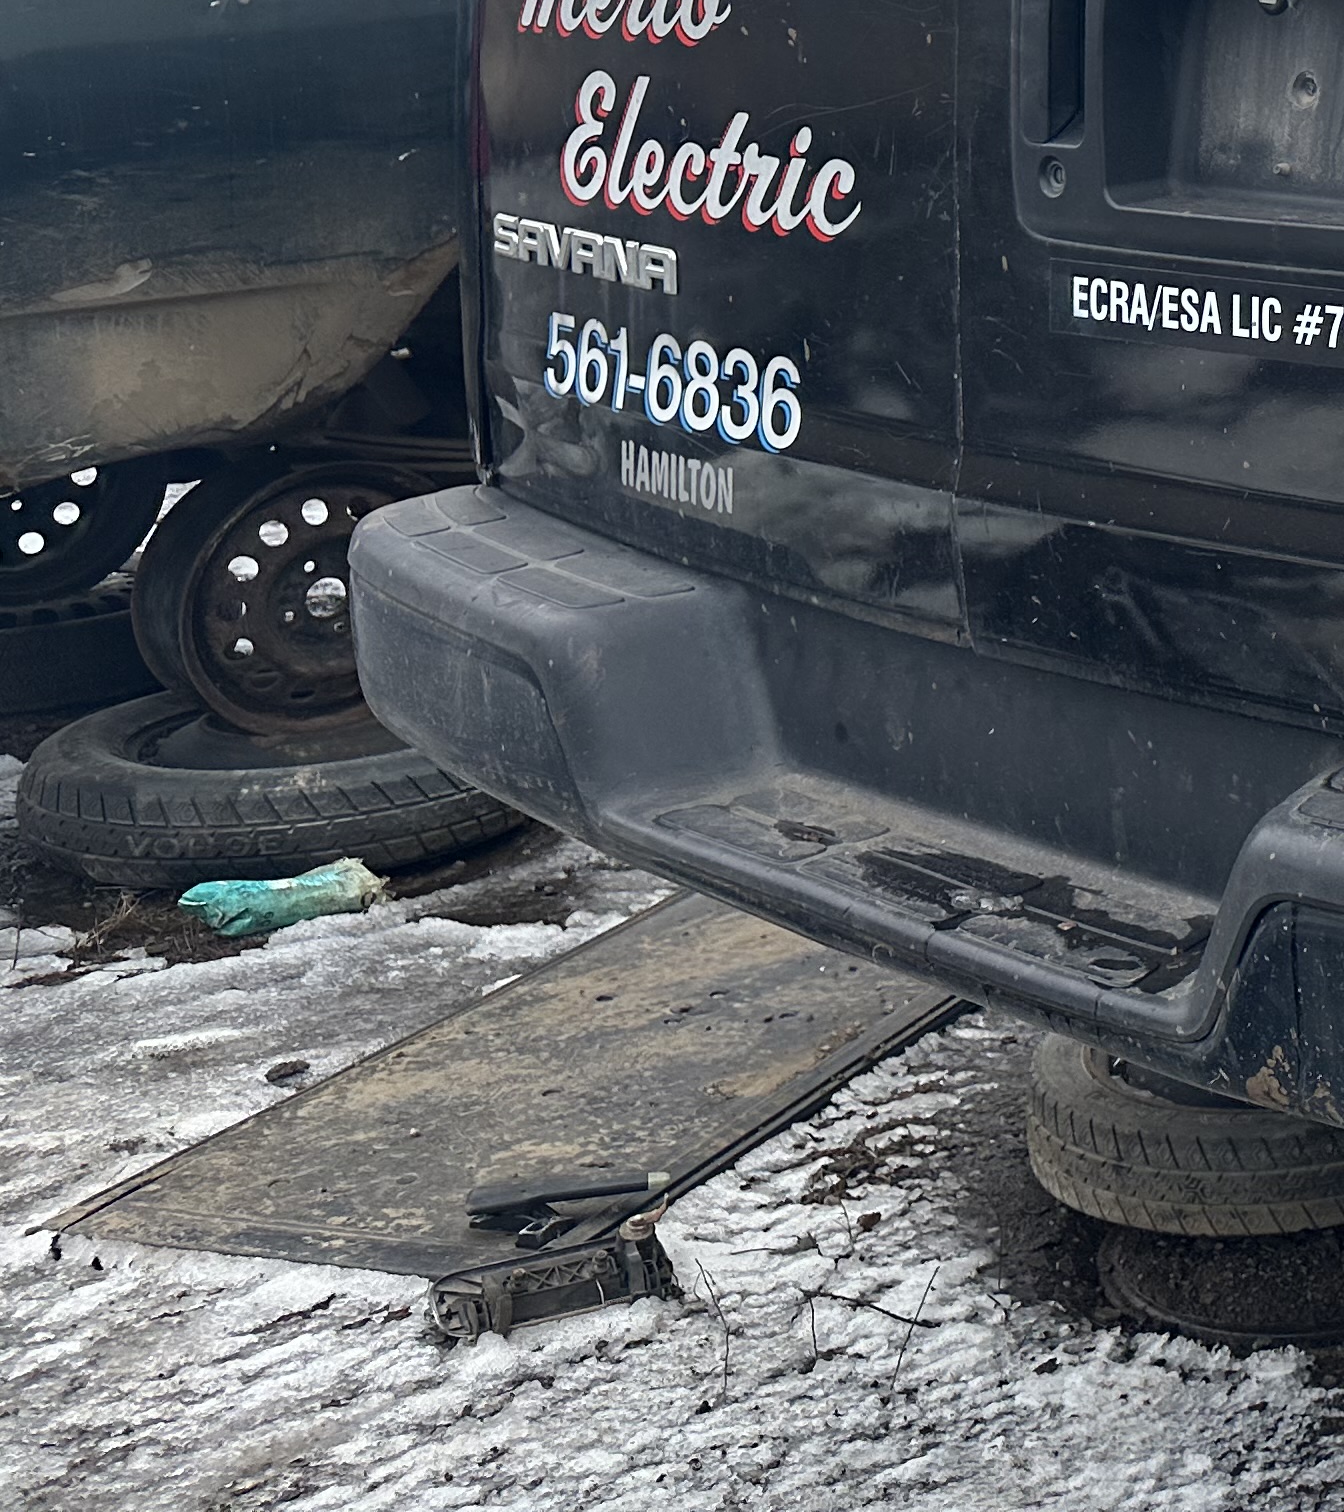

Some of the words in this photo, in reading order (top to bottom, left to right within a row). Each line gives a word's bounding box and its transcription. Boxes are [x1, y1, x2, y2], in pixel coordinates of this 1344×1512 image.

[560, 70, 862, 242] Electric
[492, 212, 679, 295] SAVANA
[1071, 275, 1222, 336] ECRA/ESA
[1231, 294, 1283, 344] LIC
[543, 311, 802, 453] 561-6836
[620, 439, 734, 515] HAMILTON
